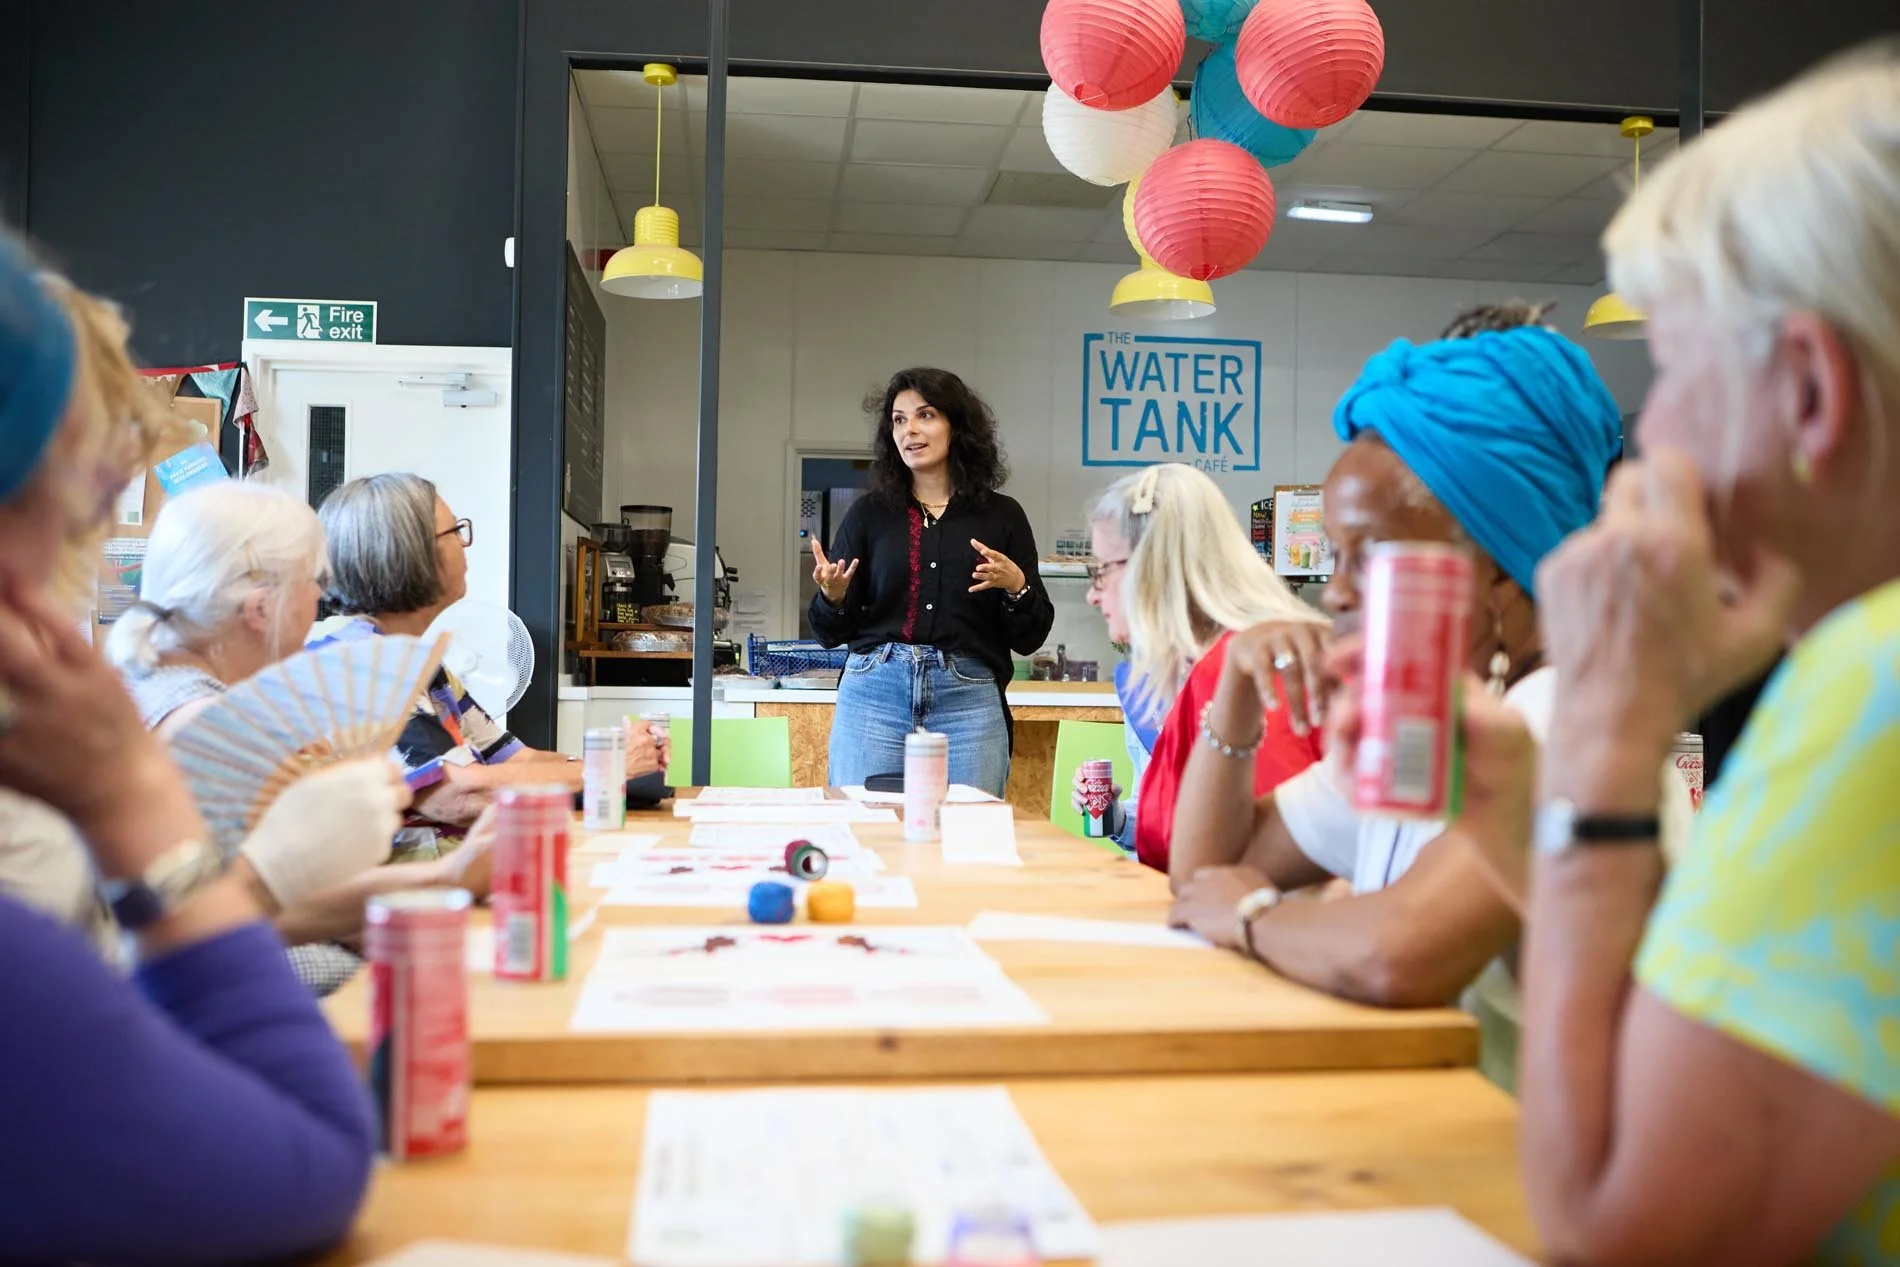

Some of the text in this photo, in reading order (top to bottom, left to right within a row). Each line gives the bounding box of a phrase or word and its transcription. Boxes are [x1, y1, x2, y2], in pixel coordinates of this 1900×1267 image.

[329, 306, 364, 323] Fire
[329, 323, 363, 340] exit
[1108, 331, 1131, 345] THE
[1100, 350, 1244, 395] WATER
[1100, 397, 1244, 455] TANK
[1194, 455, 1229, 473] CAFÉ
